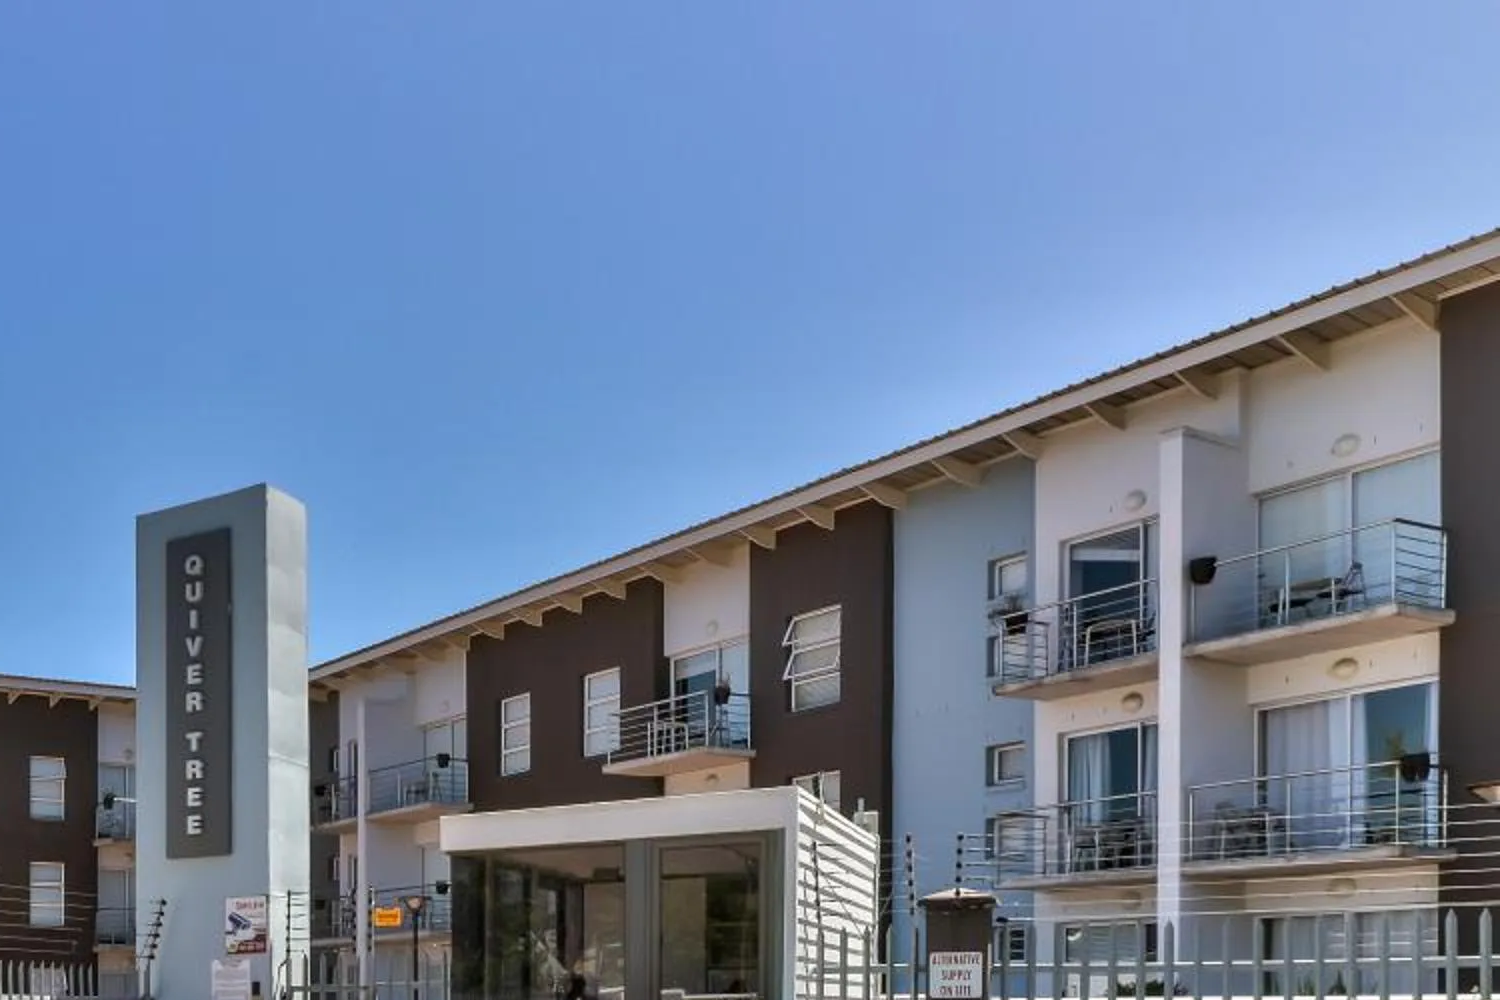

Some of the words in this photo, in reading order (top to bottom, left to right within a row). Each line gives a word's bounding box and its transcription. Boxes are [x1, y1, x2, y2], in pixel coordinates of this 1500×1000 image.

[184, 553, 204, 713] QUIVER
[184, 731, 204, 835] TREE
[940, 985, 953, 997] ON
[941, 969, 972, 981] SUPPLY
